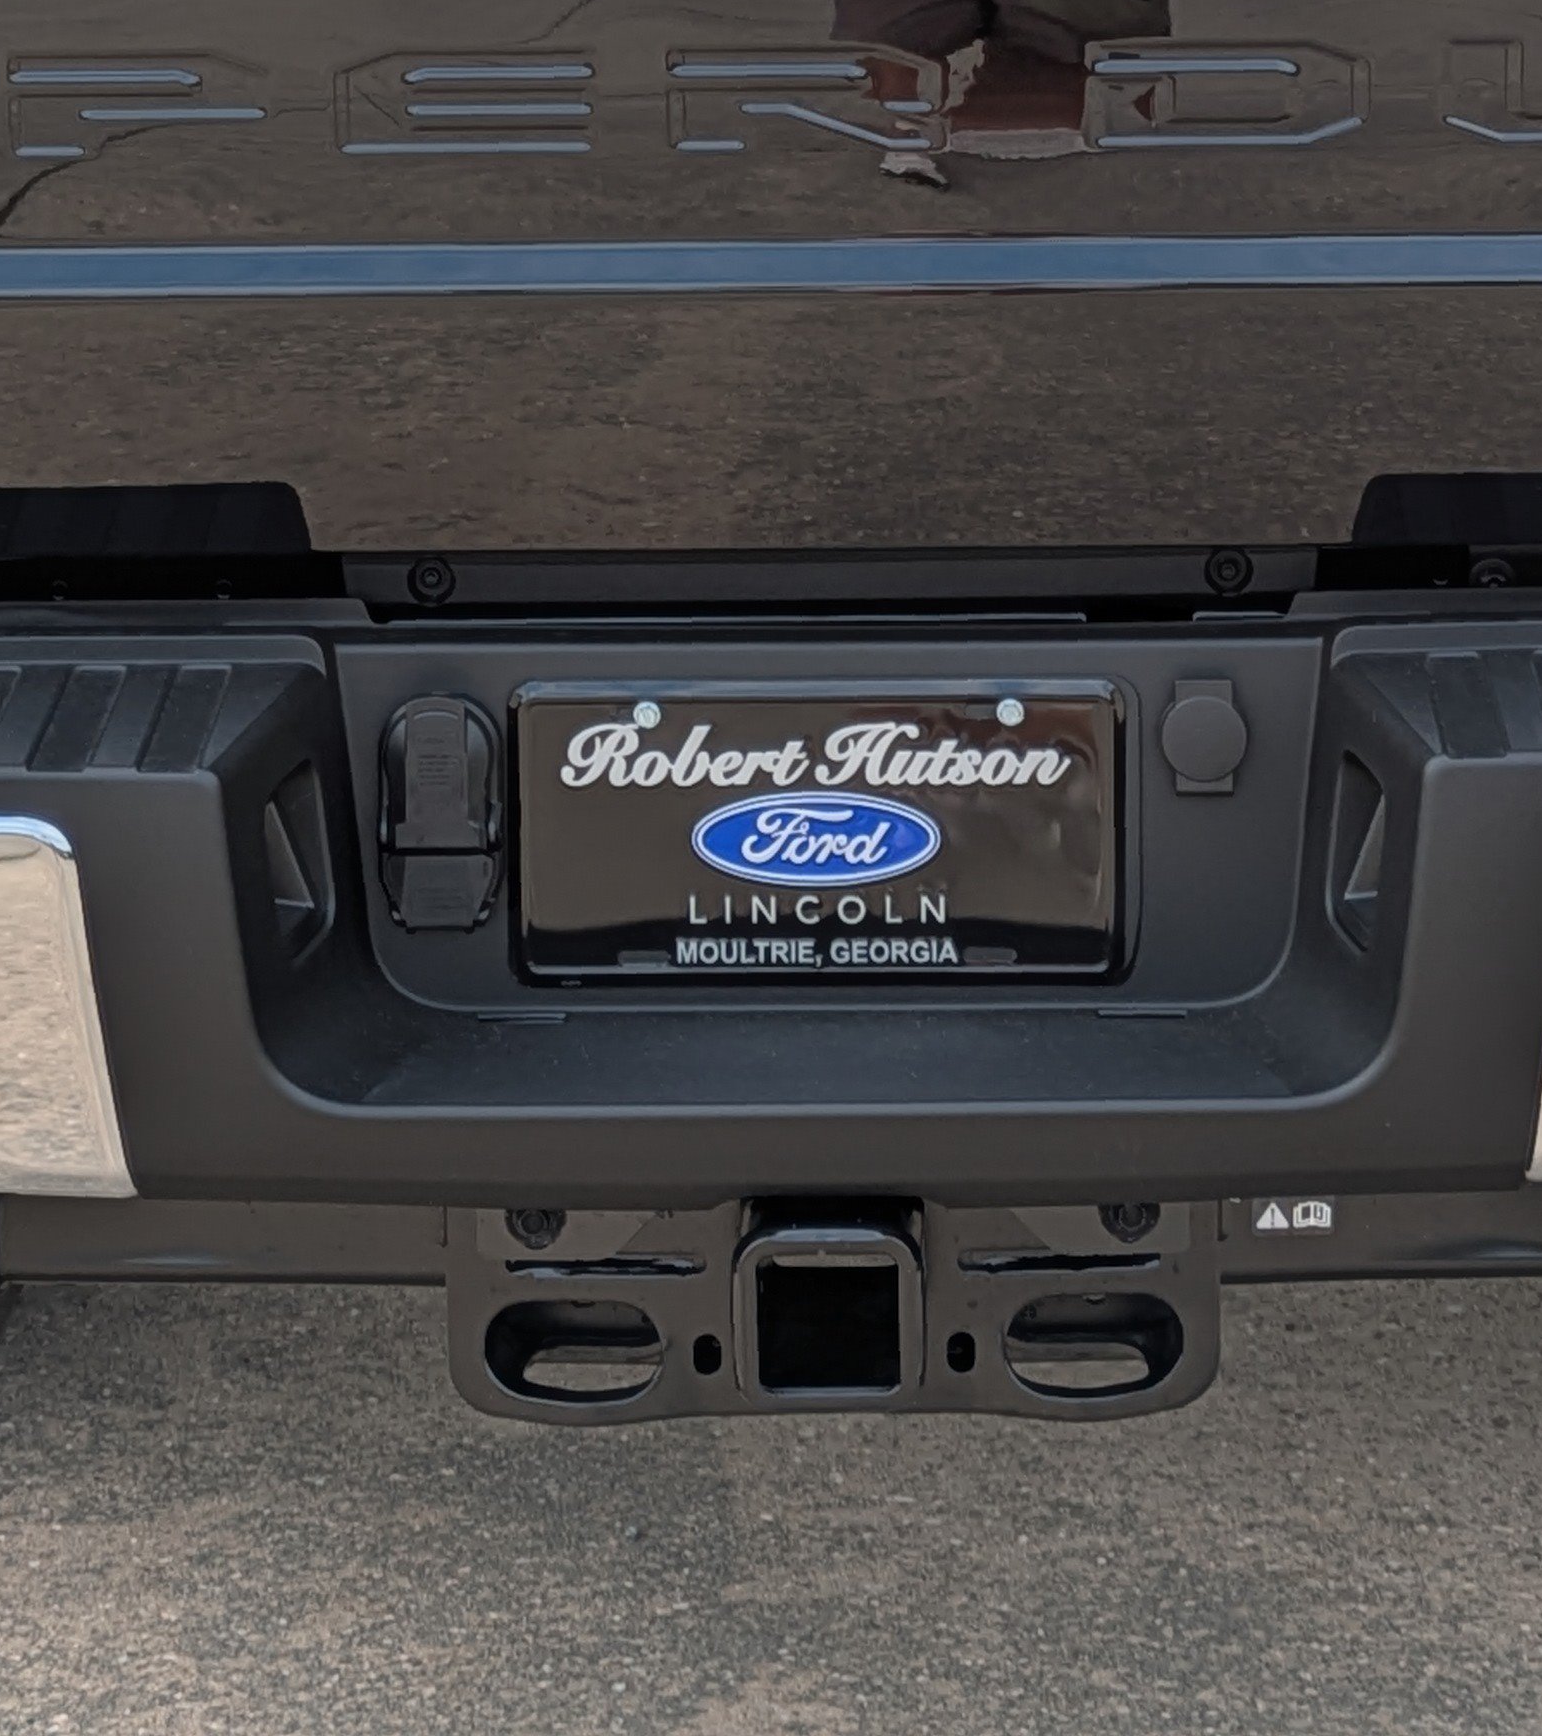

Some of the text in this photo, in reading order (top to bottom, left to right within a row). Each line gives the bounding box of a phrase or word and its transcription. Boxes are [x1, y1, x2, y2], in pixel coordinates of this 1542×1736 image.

[560, 720, 1072, 788] Robert Hutson
[740, 806, 892, 865] Ford
[689, 894, 948, 925] LINCOLN
[675, 937, 959, 968] MOULTRIE, GEORGIA
